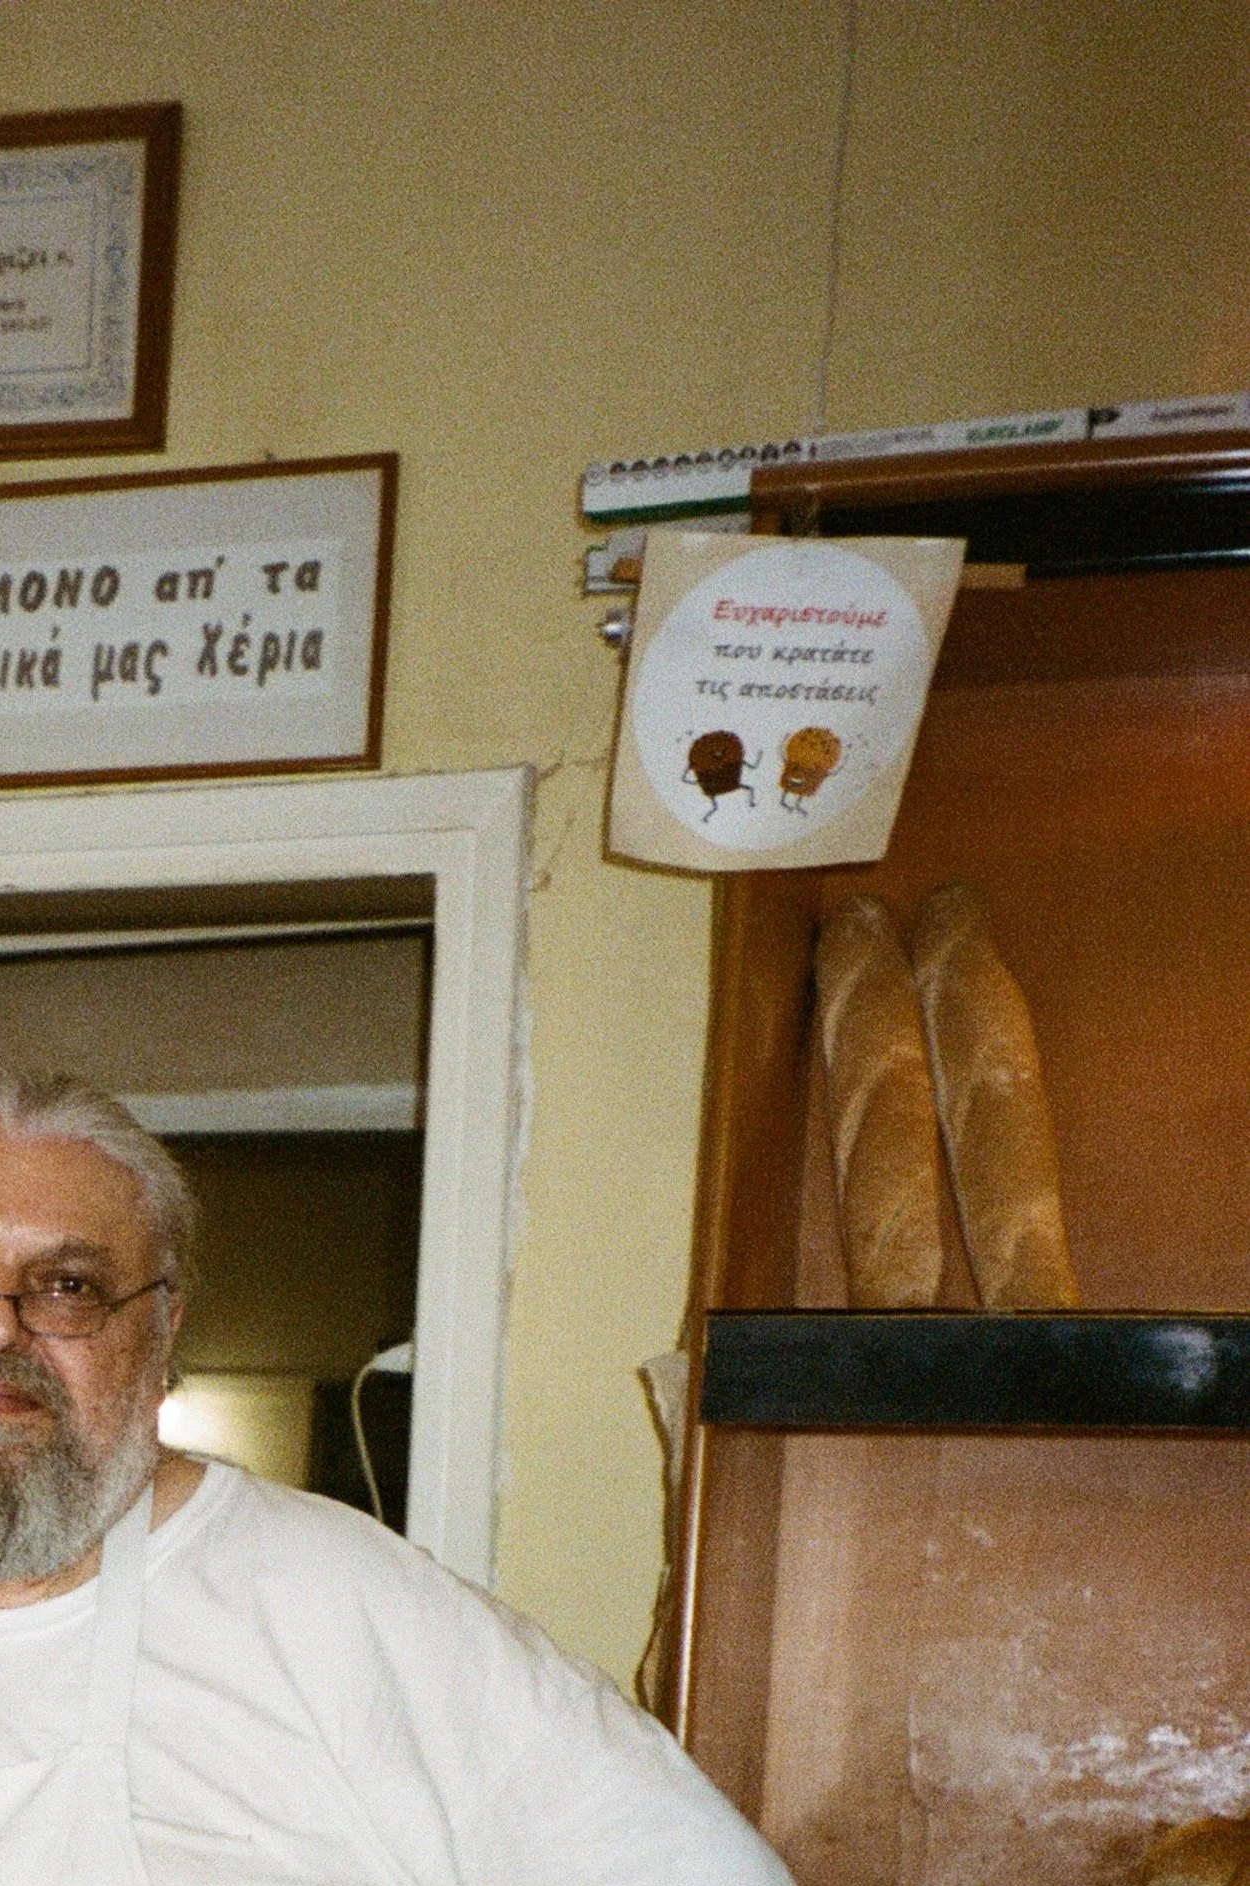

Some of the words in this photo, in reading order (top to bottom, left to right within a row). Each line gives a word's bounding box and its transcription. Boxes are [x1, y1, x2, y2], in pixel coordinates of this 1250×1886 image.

[261, 559, 322, 595] τα
[713, 598, 888, 629] Ευχαριστούμε
[91, 637, 169, 702] μας
[196, 612, 324, 687] Χέρια
[713, 643, 762, 660] που
[771, 639, 874, 666] κρατάτε
[695, 679, 733, 703] τις
[738, 677, 879, 706] αποστάσεις
